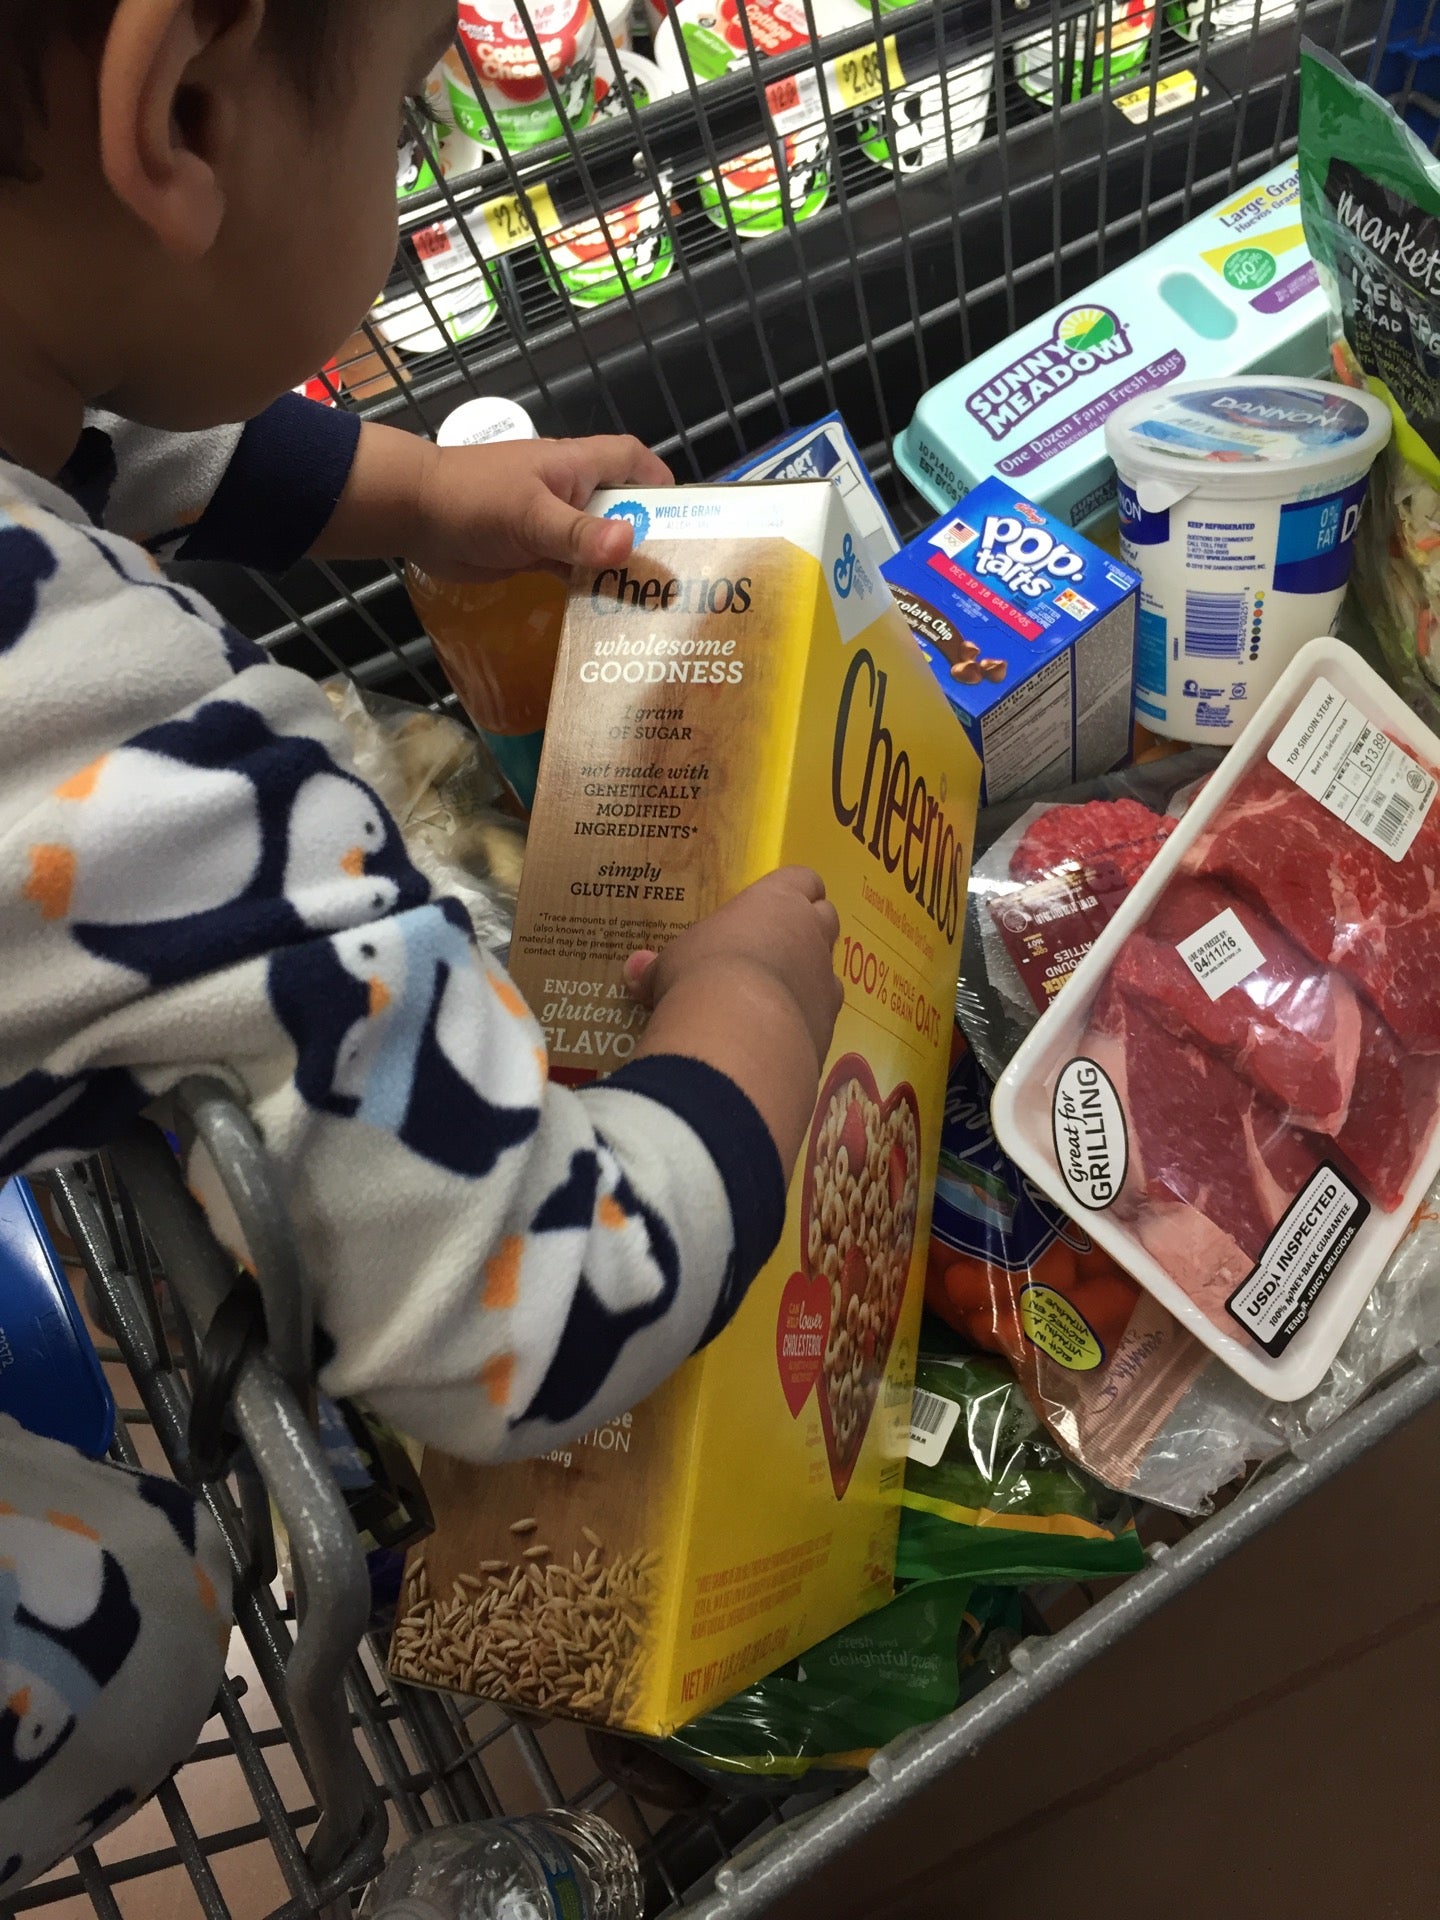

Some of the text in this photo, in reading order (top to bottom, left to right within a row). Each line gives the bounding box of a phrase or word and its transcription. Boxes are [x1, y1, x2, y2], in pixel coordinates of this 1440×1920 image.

[1219, 168, 1300, 228] Large Grad
[1235, 187, 1300, 233] Huevos Grand
[493, 197, 537, 238] $2.8
[1337, 190, 1440, 297] Markets
[1352, 298, 1403, 334] SALAD
[969, 338, 1070, 420] SUNNY
[981, 336, 1131, 438] MEADOW
[1000, 449, 1031, 473] One
[1030, 424, 1073, 453] Dozen
[1072, 397, 1109, 428] Farm
[1107, 371, 1149, 405] Fresh
[1147, 352, 1183, 386] Eggs
[1211, 396, 1343, 427] DANNON
[655, 505, 721, 518] WHOLE GRAIN
[1187, 521, 1256, 531] KEEP REFRIGERATED
[1320, 506, 1338, 527] 0%
[1316, 525, 1338, 550] FAT
[591, 568, 752, 616] Cheerios
[949, 565, 966, 580] DEC
[965, 577, 977, 589] 10
[594, 633, 737, 657] wholesome
[931, 619, 953, 641] Chip
[579, 660, 744, 685] GOODNESS
[634, 706, 684, 723] gram
[1285, 692, 1336, 766] TOP SIRLOIN STEAK
[608, 726, 692, 741] OF SUGAR
[1351, 740, 1365, 756] TOTAL
[1359, 731, 1388, 773] $13.89
[579, 763, 710, 780] not made with
[583, 783, 702, 800] GENETICALLY
[831, 648, 964, 945] Cheerios
[595, 802, 682, 820] MODIFIED
[598, 860, 662, 883] simply
[570, 881, 686, 902] GLUTEN FREE
[533, 924, 554, 934] (also
[555, 925, 585, 935] known
[586, 928, 597, 936] as
[652, 932, 678, 942] engin
[569, 915, 606, 926] amounts
[608, 916, 618, 926] of
[620, 919, 667, 930] genetically
[518, 935, 555, 945] material
[556, 938, 574, 948] may
[576, 938, 588, 947] be
[589, 940, 624, 951] present
[626, 941, 643, 951] due
[523, 946, 629, 962] contact during manufact
[1053, 938, 1098, 964] ATTIES
[1193, 936, 1237, 973] 04/11/16
[543, 978, 629, 999] ENJOY AL
[842, 935, 942, 1049] 100% WHOLE GRAIN OATS
[540, 997, 650, 1030] gluten fr
[542, 1025, 636, 1058] FLAVO
[1057, 1090, 1089, 1183] Great for
[1076, 1066, 1114, 1202] GRILLING
[1246, 1183, 1338, 1318] USDA INSPECTED
[1268, 1202, 1351, 1328] 100% MONEY-BACK GUARANTEE
[1307, 1271, 1328, 1300] JUICY.
[1323, 1226, 1357, 1273] DELICIOUS.
[799, 1300, 823, 1331] lower
[1044, 1296, 1087, 1336] VITAMINE
[782, 1333, 823, 1357] CHOLESTEROL
[1034, 1330, 1072, 1361] RICH IN
[1043, 1323, 1081, 1357] VITAMIN
[828, 1650, 908, 1668] delightful
